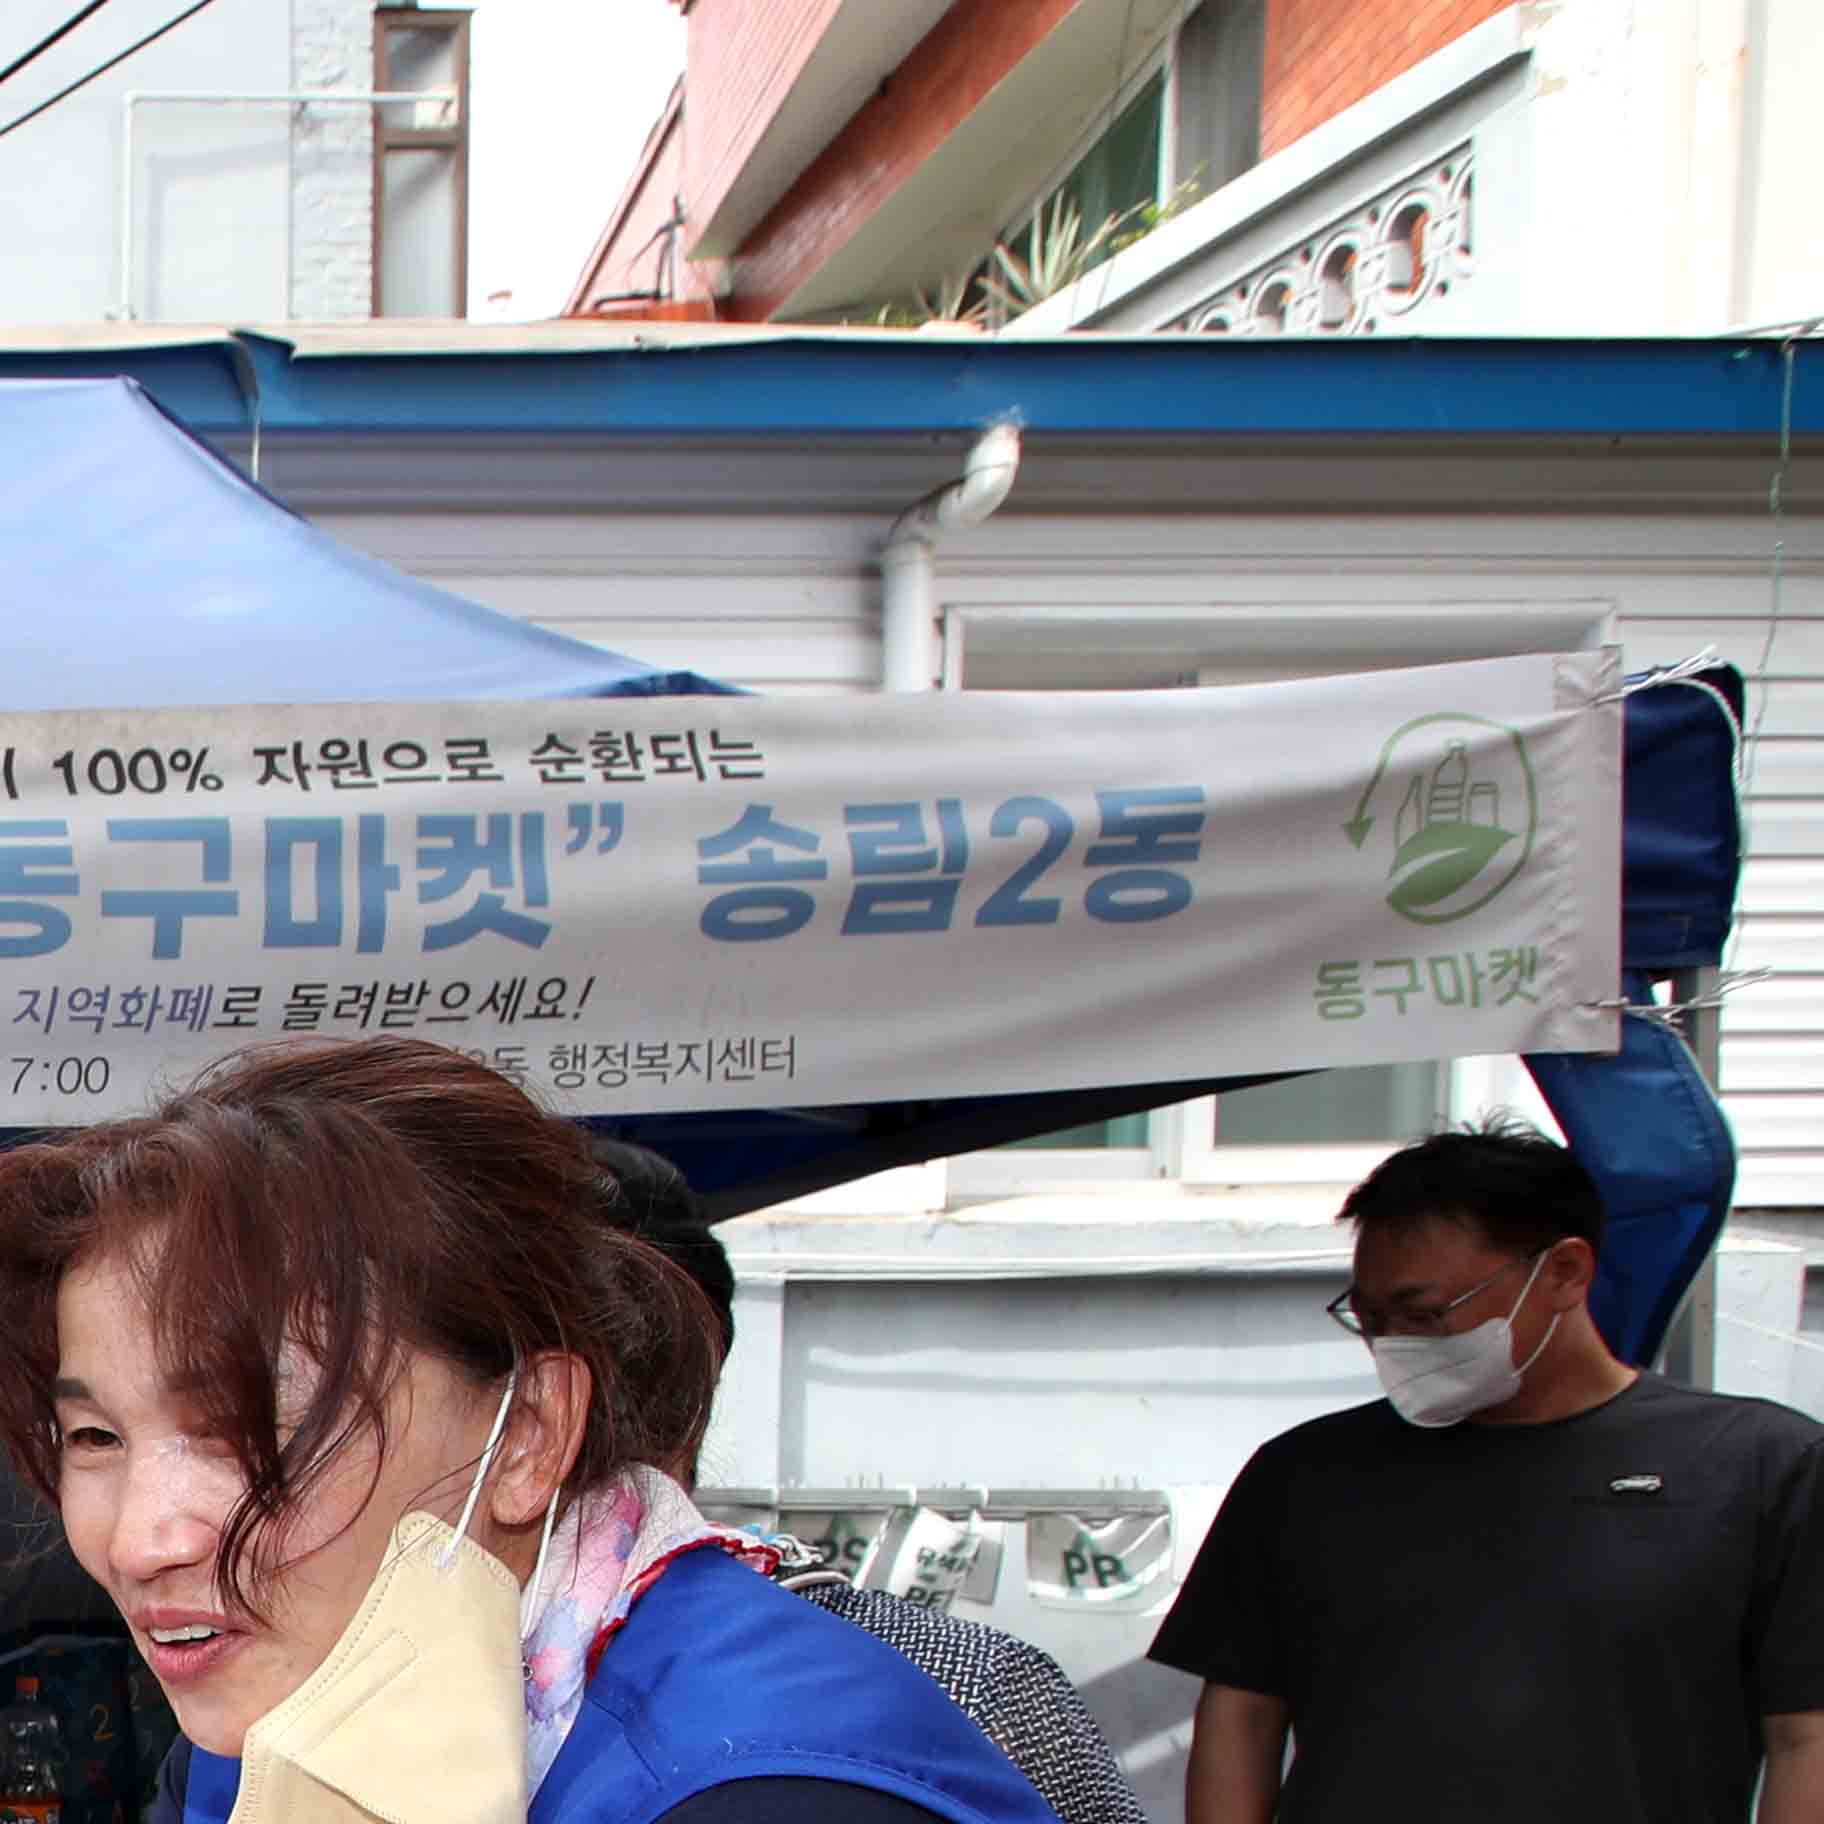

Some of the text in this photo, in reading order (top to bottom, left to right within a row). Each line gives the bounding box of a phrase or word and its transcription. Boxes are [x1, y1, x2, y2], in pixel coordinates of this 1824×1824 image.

[52, 747, 225, 797] 100%
[253, 737, 523, 792] 자원으로
[527, 729, 765, 785] 순환되는
[695, 785, 1206, 943] 송림2동
[12, 983, 260, 1034] 지역화폐로
[281, 975, 595, 1033] 돌려받으세요!
[1312, 944, 1543, 1022] 동구마켓
[551, 1036, 795, 1089] 행정복지센터
